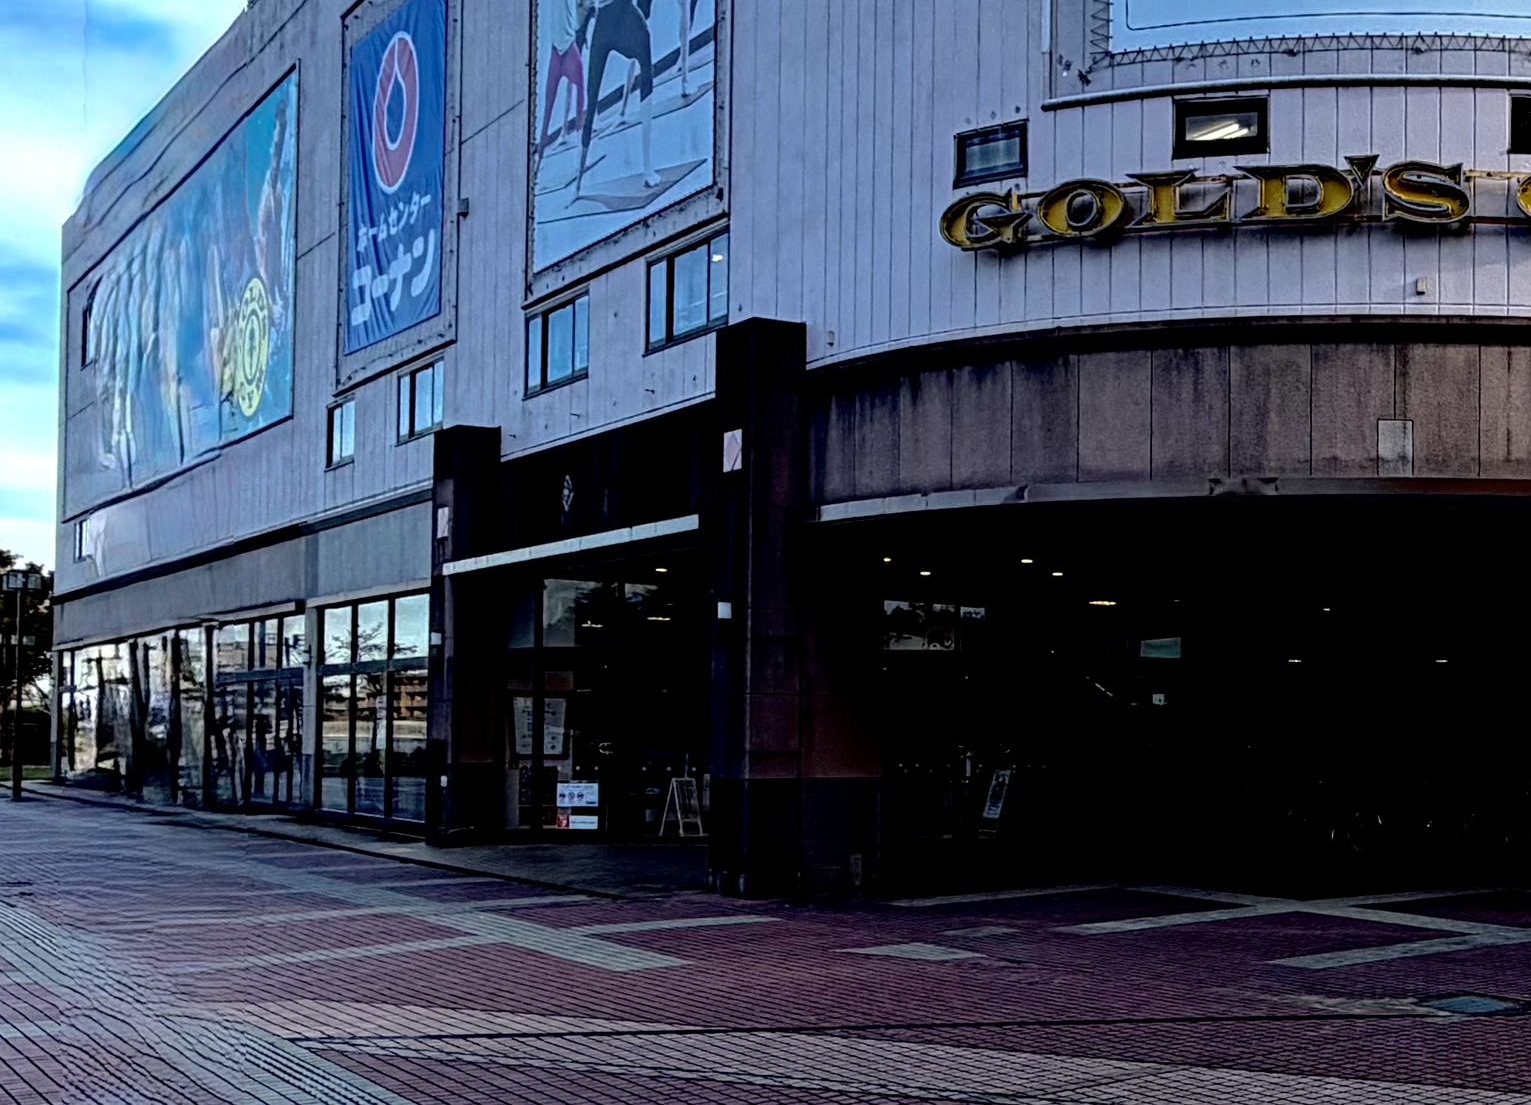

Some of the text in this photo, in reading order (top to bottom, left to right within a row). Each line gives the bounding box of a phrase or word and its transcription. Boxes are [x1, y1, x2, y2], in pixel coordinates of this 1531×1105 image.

[356, 190, 432, 253] ホームセンター
[938, 153, 1470, 251] GOLD'S
[350, 227, 436, 327] コーナン
